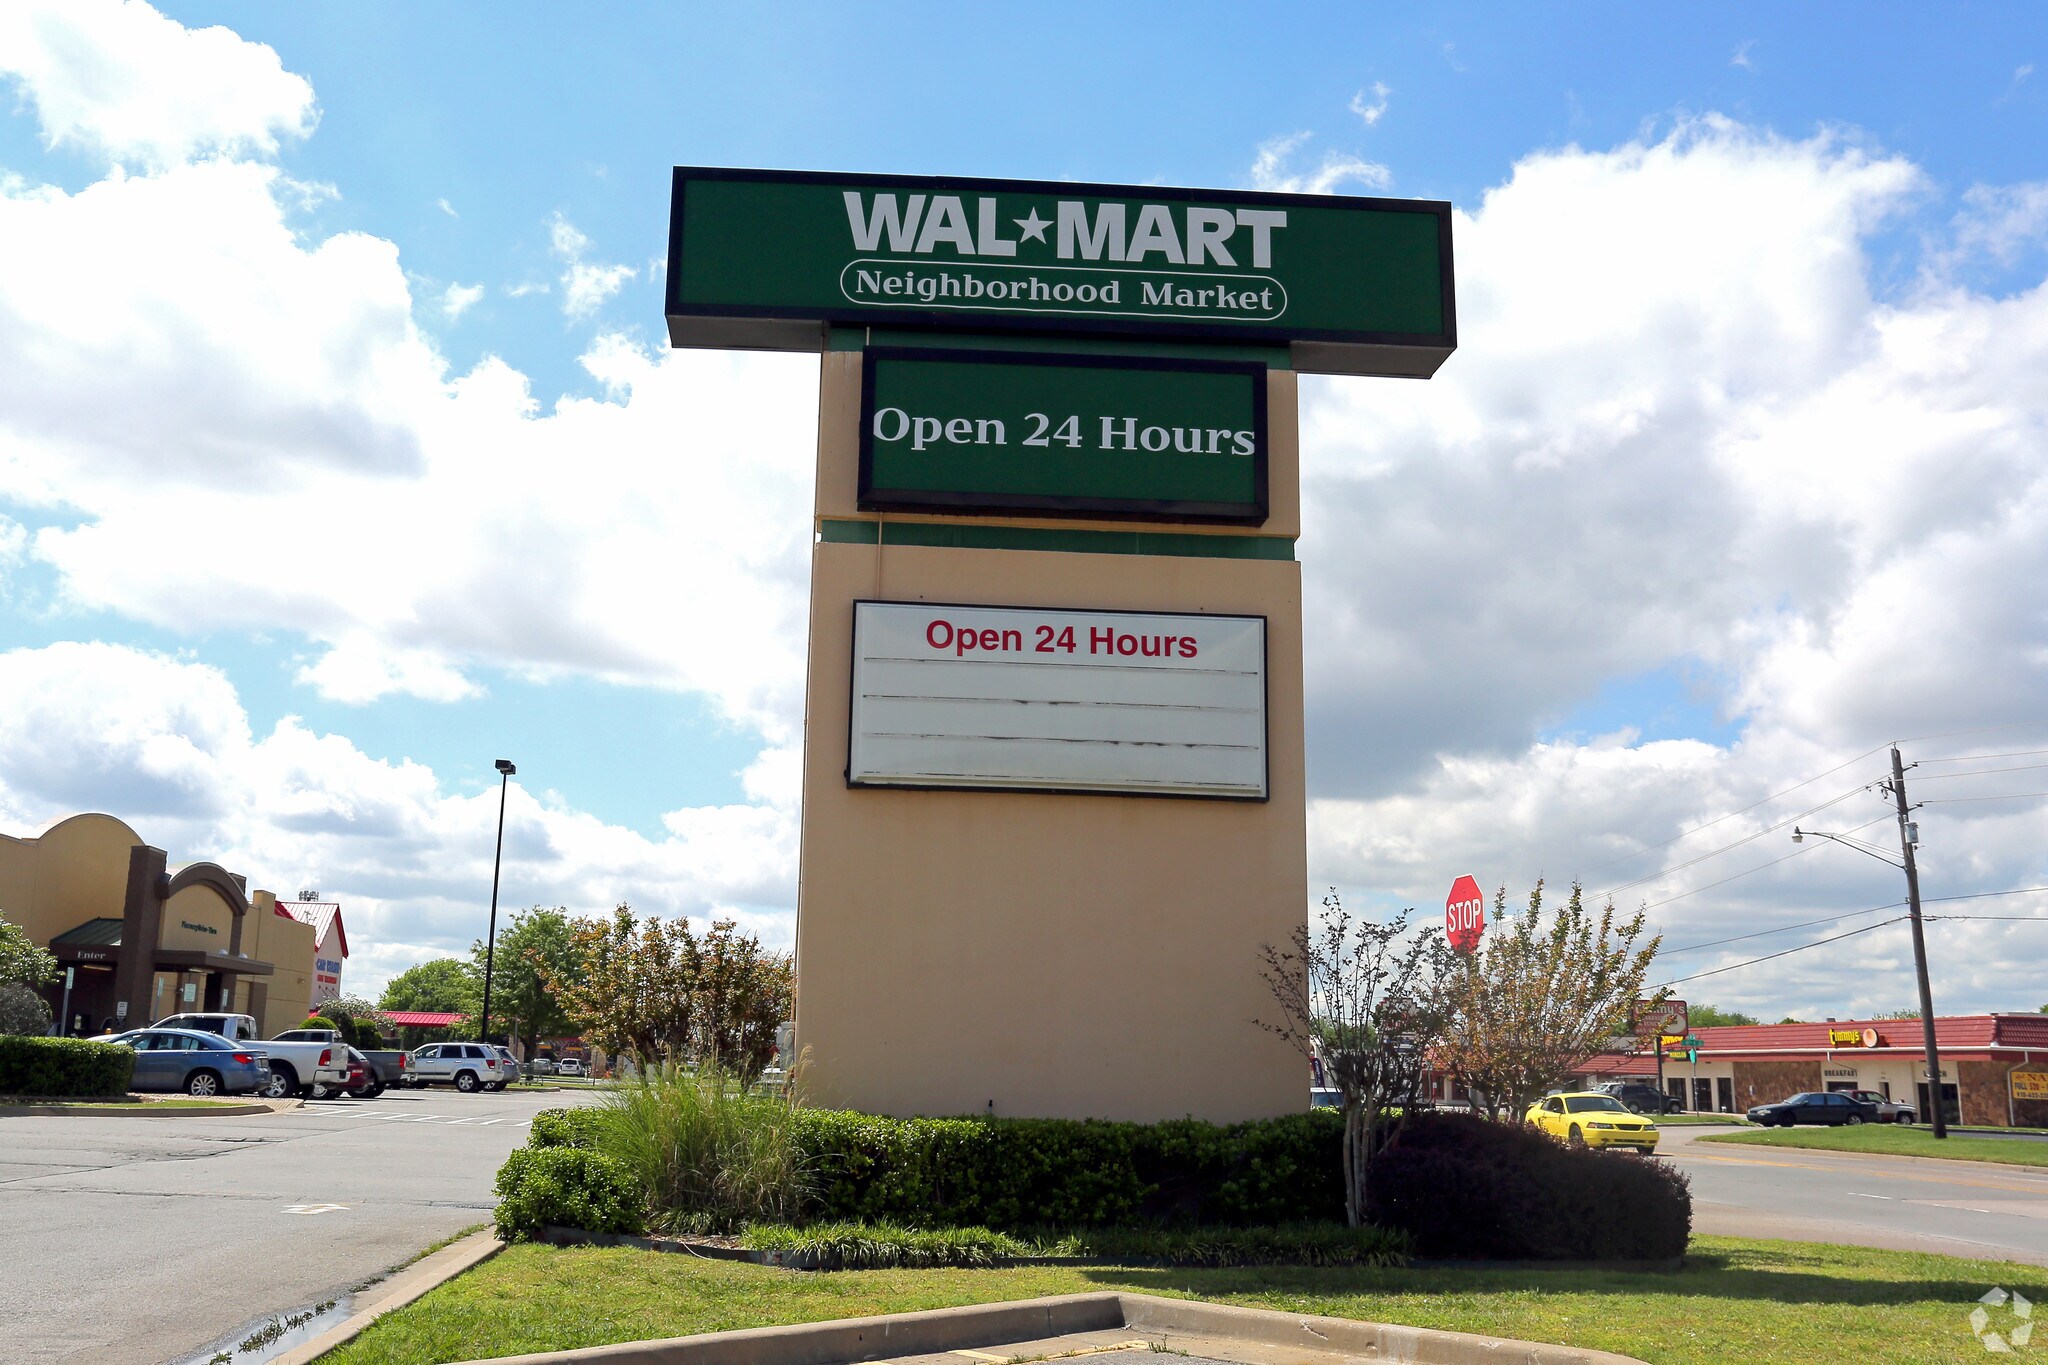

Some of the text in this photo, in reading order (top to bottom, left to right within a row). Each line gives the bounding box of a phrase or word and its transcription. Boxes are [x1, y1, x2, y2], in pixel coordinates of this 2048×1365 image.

[855, 270, 1274, 311] Neighborhood Market
[872, 406, 1256, 457] Open 24 Hours
[926, 619, 1198, 659] Open 24 Hours
[1448, 898, 1481, 933] STOP
[77, 951, 106, 960] Enter
